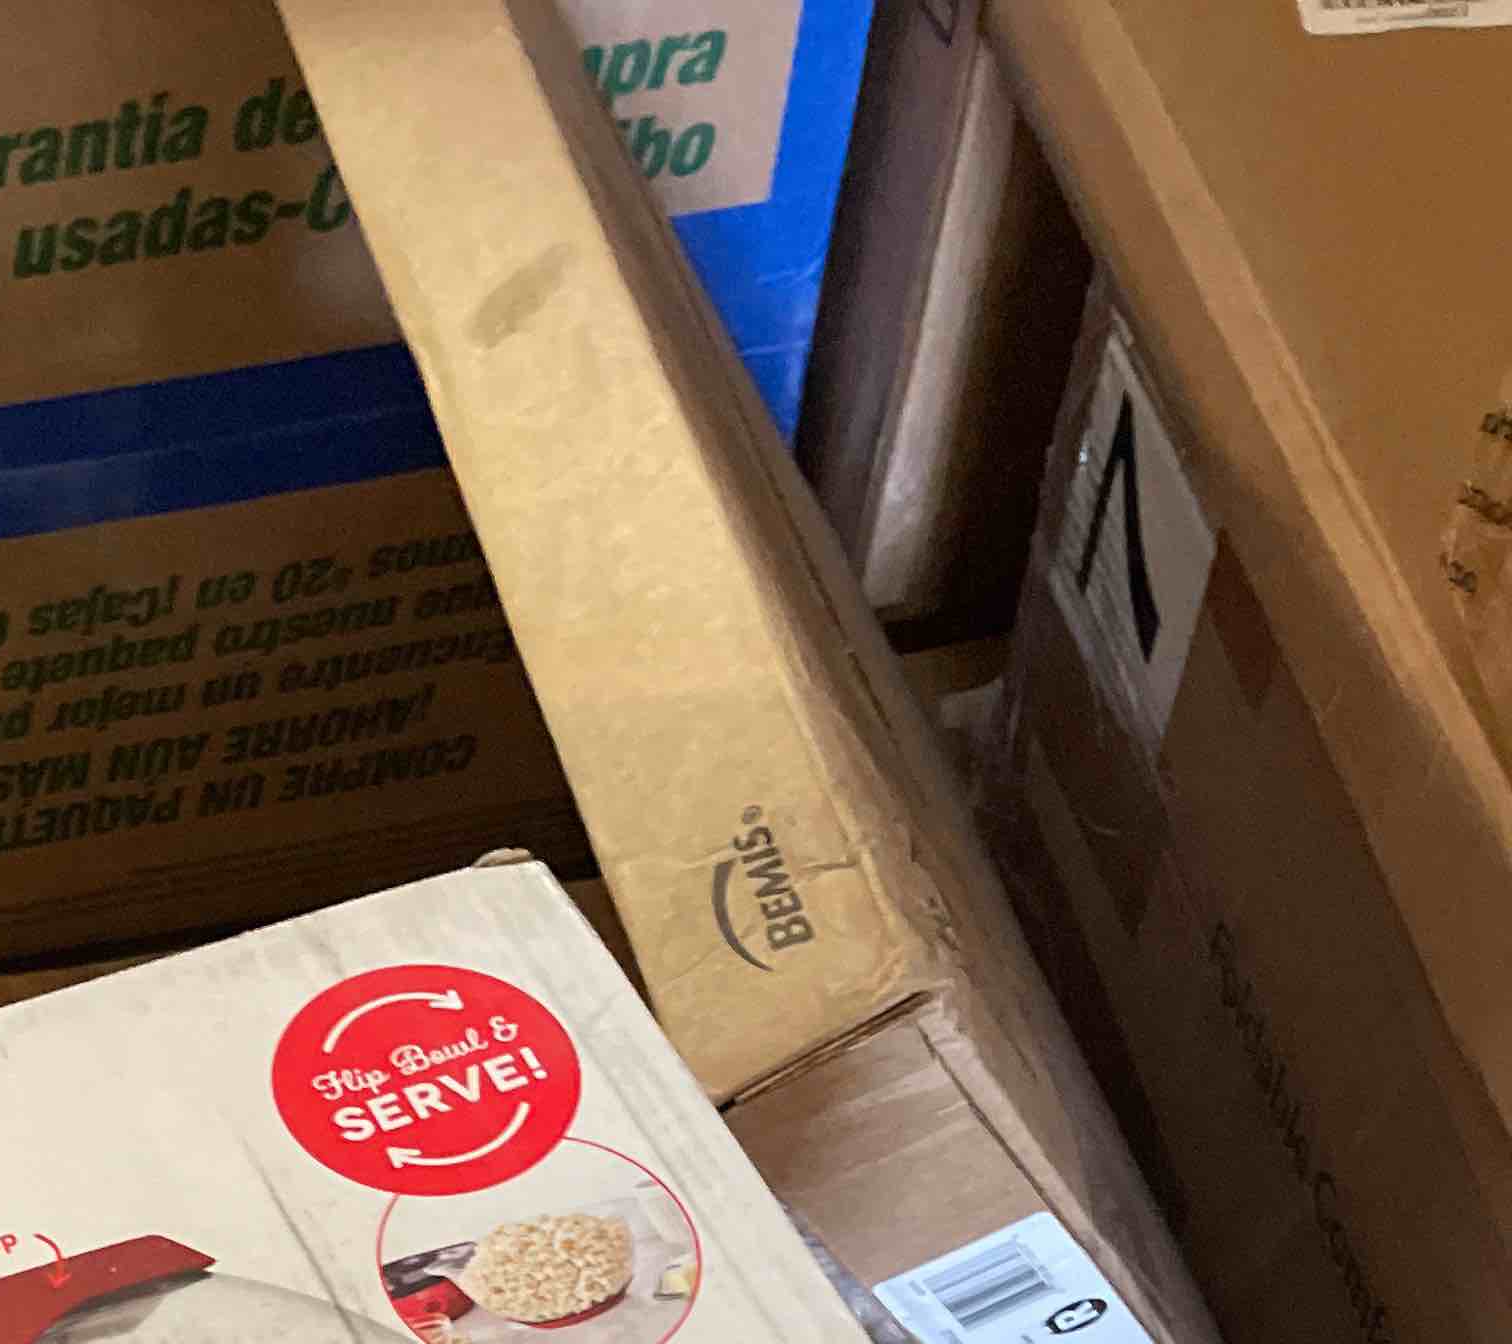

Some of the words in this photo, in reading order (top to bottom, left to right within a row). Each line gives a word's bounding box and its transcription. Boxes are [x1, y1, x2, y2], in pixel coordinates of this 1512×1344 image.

[198, 570, 255, 609] en
[214, 595, 399, 652] nuestro
[1, 624, 200, 685] paquete
[201, 660, 261, 706] un
[47, 679, 185, 736] mejor
[108, 732, 212, 788] AÚN
[280, 732, 478, 803] COMPRE
[197, 769, 265, 819] UN
[311, 1067, 390, 1103] Flip
[389, 1027, 490, 1076] Bowl
[488, 1014, 520, 1043] &
[333, 1046, 549, 1144] SERVE!
